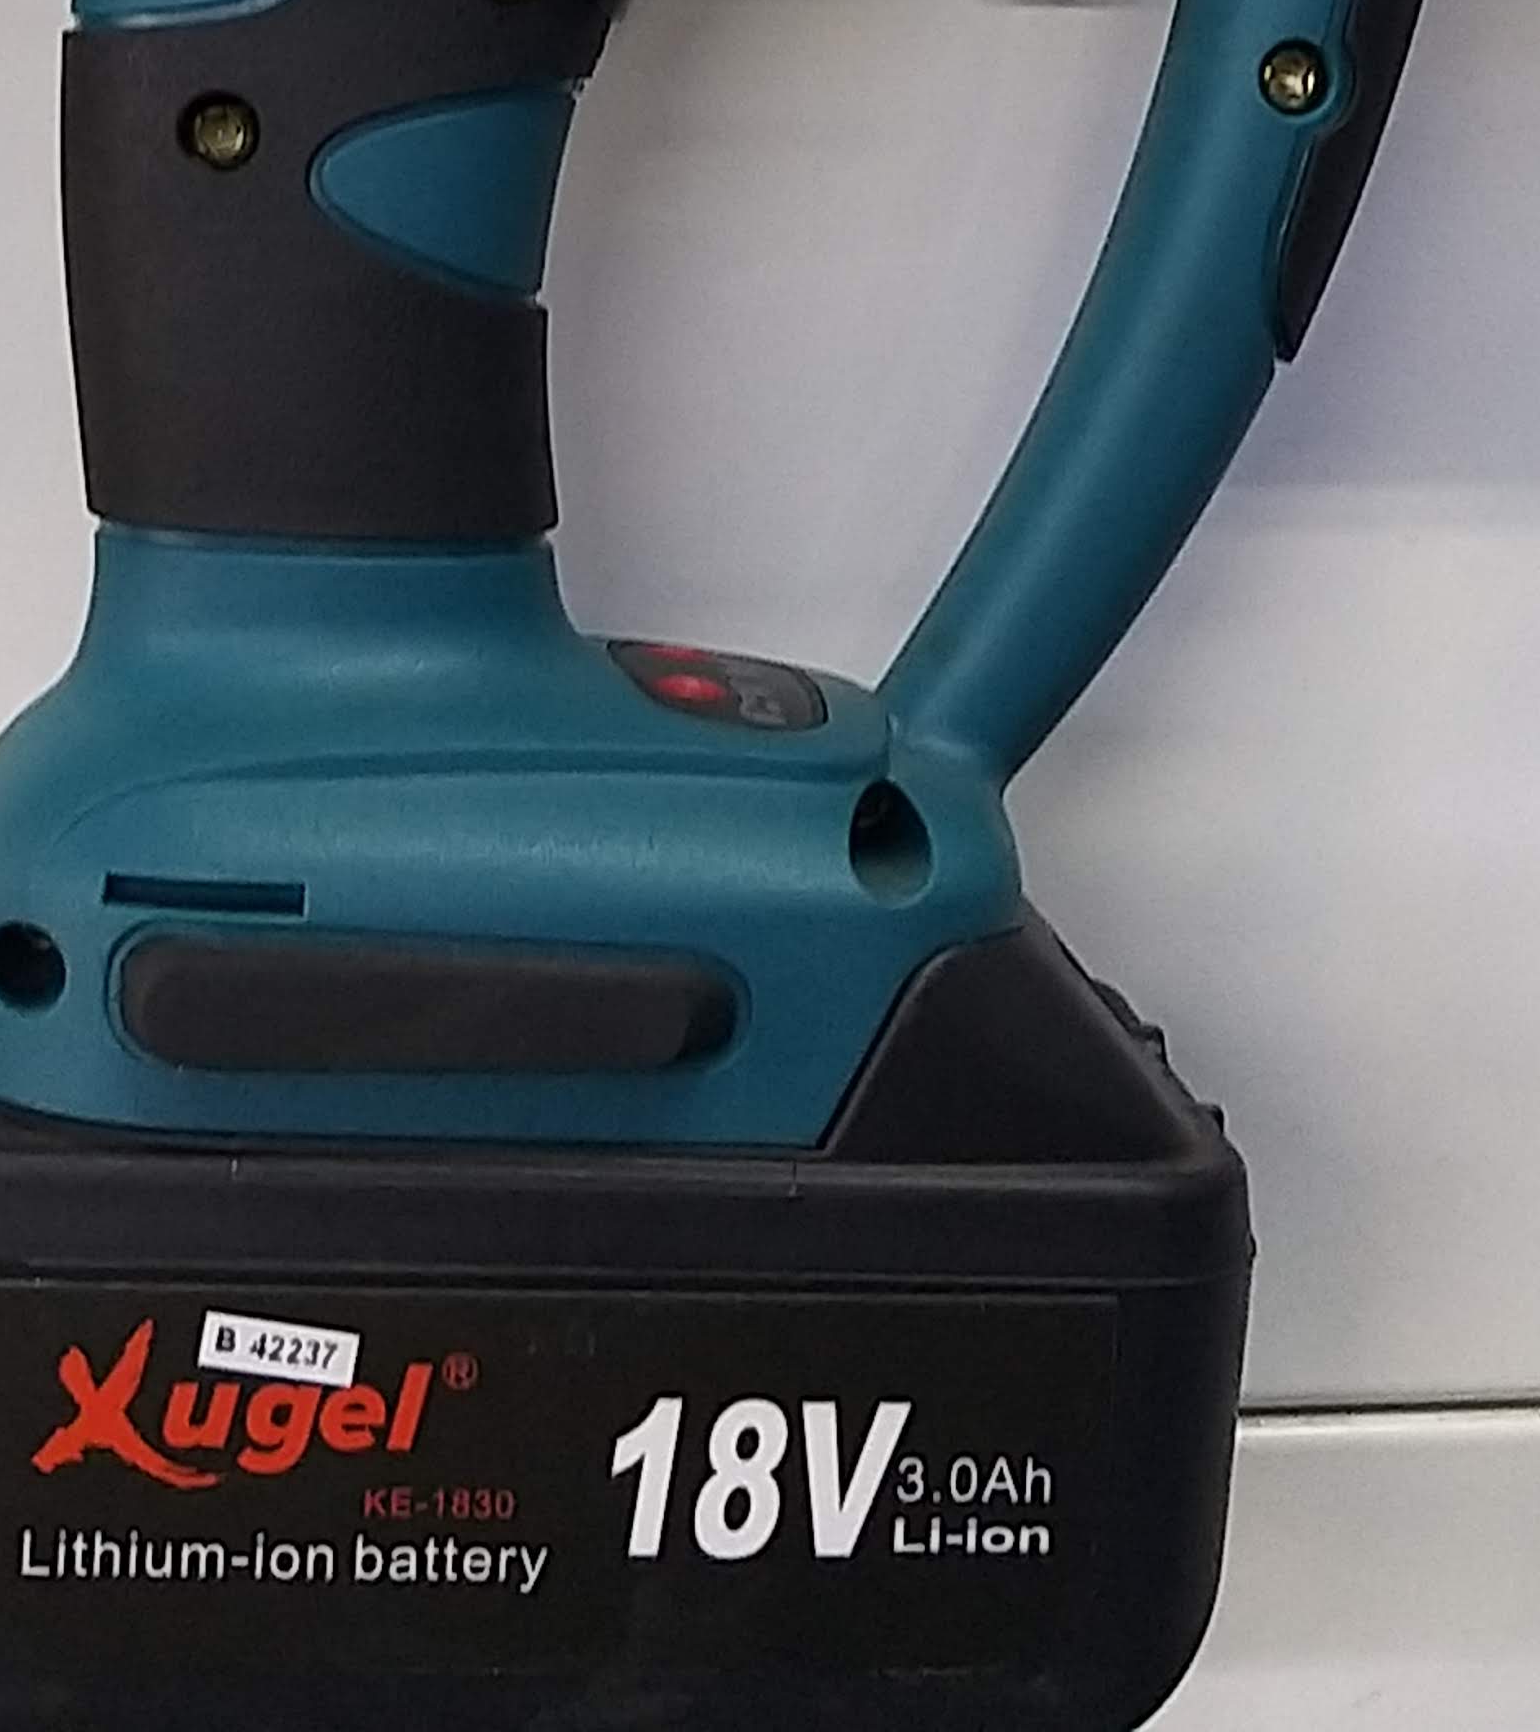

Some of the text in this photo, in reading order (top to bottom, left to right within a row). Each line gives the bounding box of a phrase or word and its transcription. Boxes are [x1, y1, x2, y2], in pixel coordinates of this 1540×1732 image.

[214, 1325, 338, 1370] B 42237
[31, 1318, 434, 1489] Xugel
[362, 1487, 517, 1521] KE-1830
[610, 1396, 912, 1560] 18V
[896, 1456, 1052, 1504] 3.0Ah
[20, 1528, 549, 1594] Lithium-ion battery
